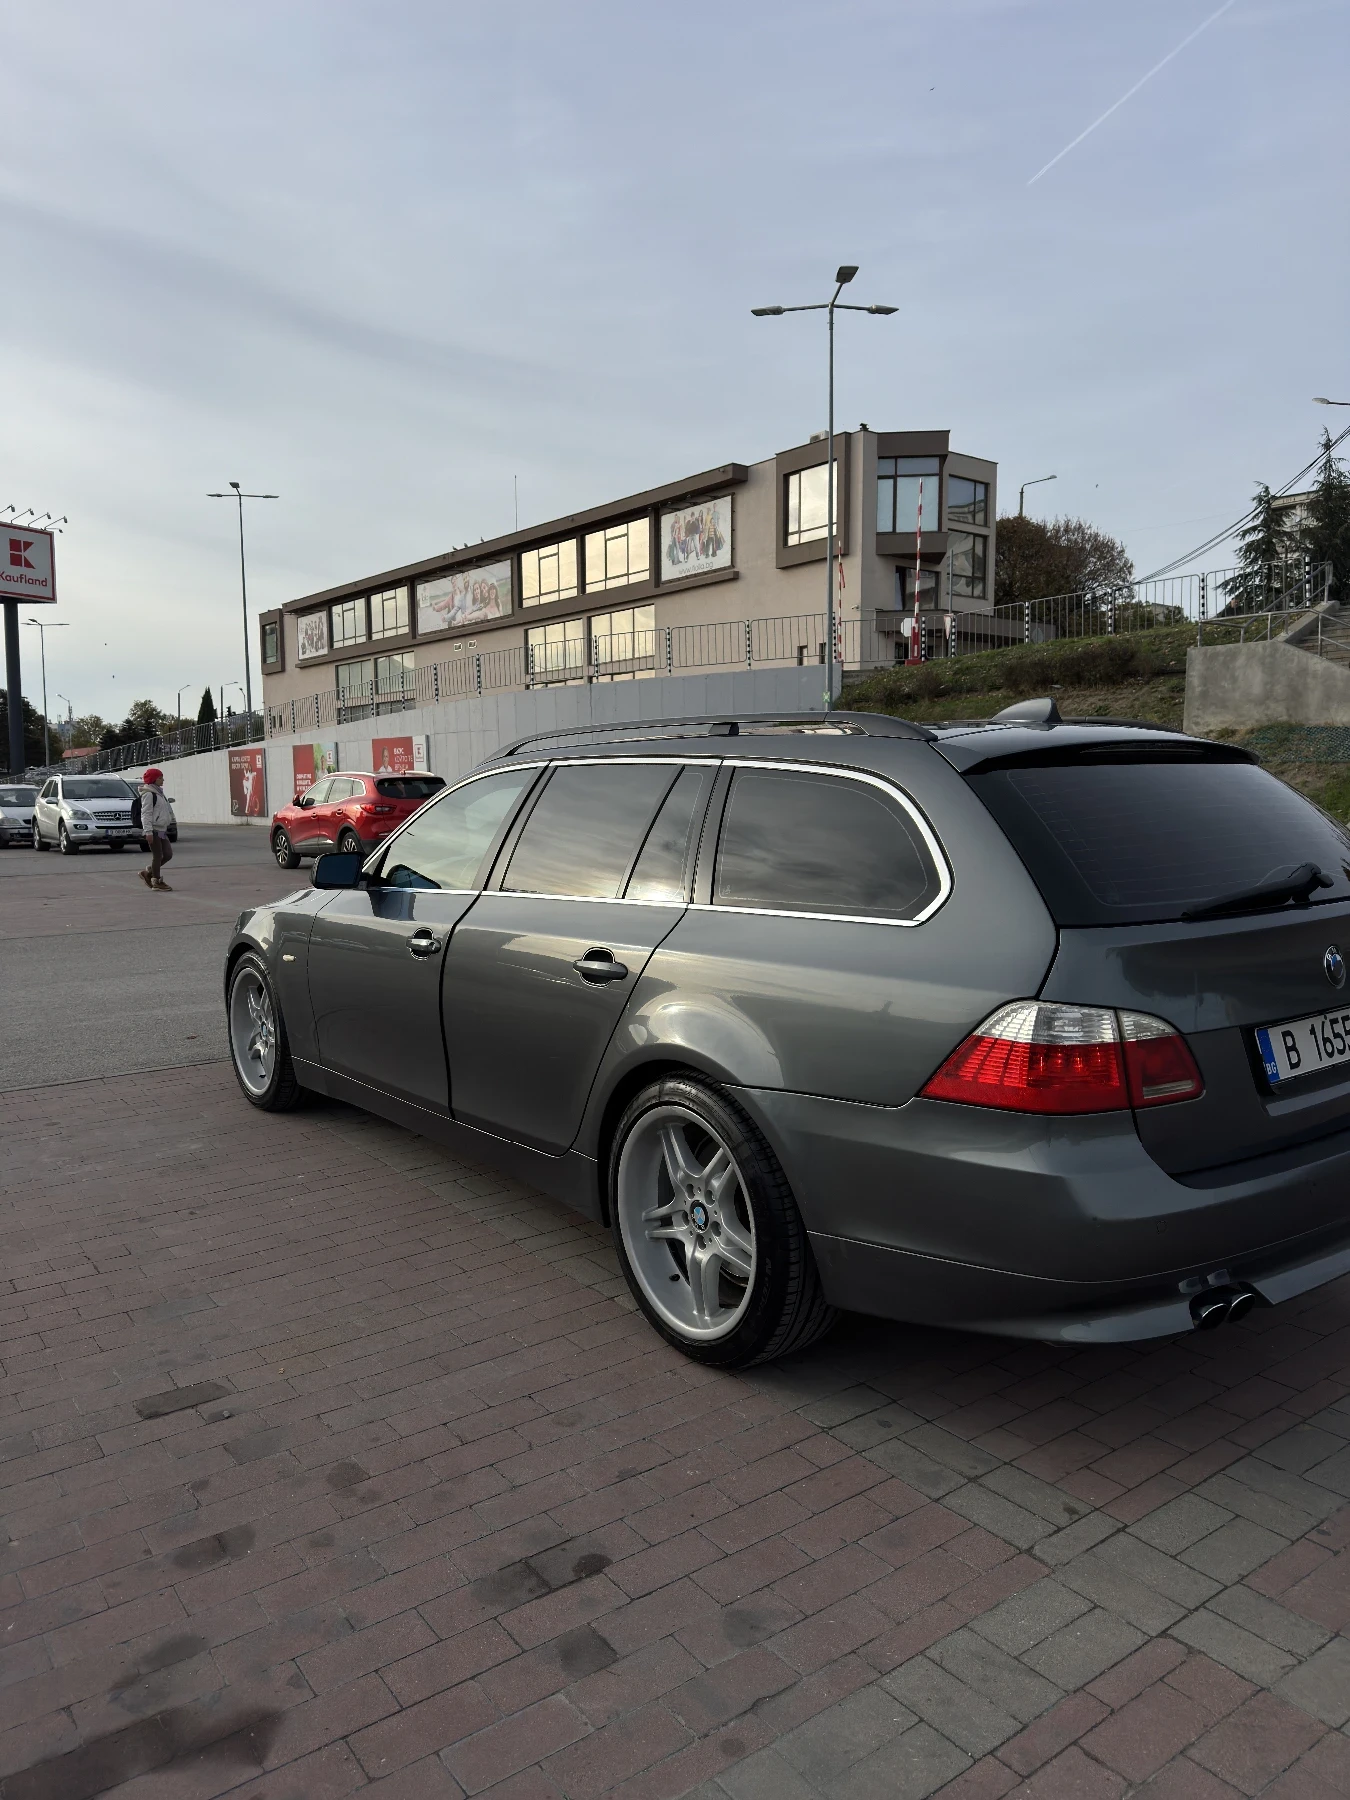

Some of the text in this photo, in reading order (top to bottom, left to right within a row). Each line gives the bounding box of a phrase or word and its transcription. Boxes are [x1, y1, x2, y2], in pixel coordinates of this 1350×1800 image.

[9, 537, 36, 570] K
[0, 571, 48, 587] Kaufland
[1281, 1030, 1301, 1070] B
[1266, 1061, 1277, 1074] BG
